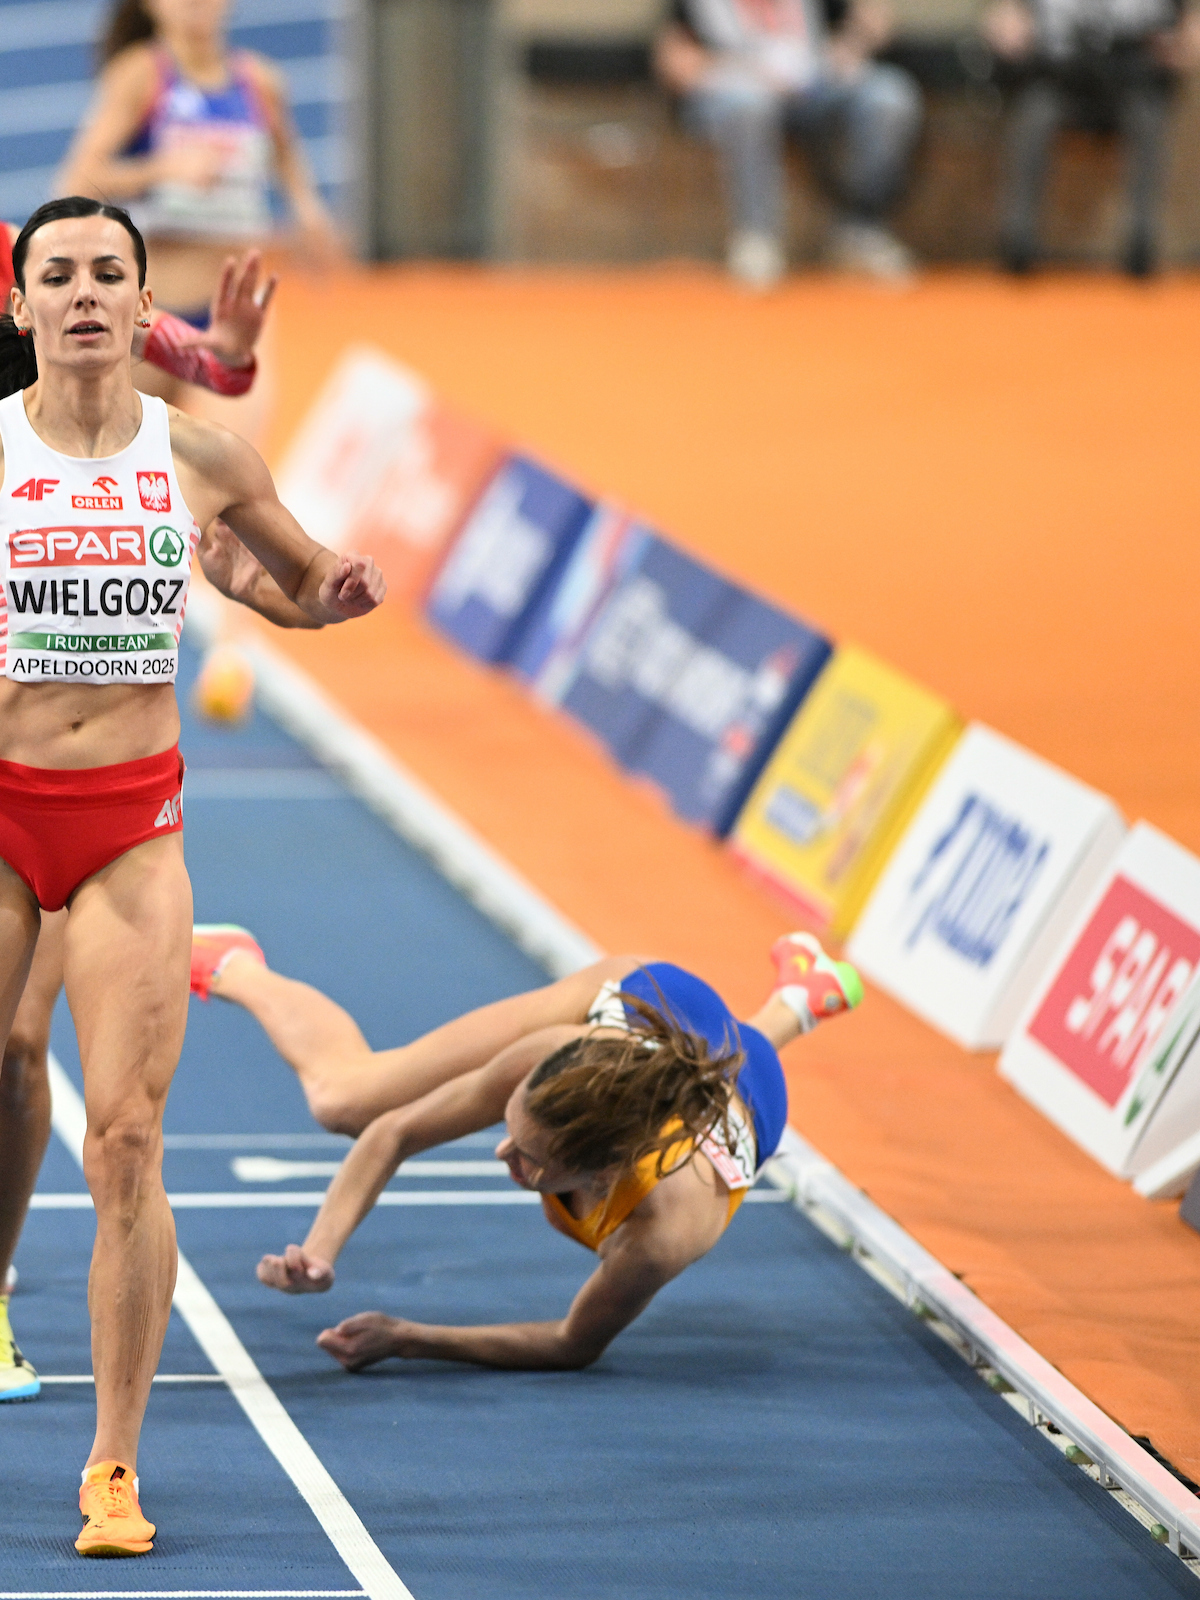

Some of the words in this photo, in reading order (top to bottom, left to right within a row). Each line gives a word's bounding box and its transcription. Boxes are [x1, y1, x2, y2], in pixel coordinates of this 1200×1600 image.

[74, 496, 120, 509] ORLEN
[11, 530, 143, 563] SPAR
[9, 577, 183, 617] WIELGOSZ
[46, 634, 51, 649] I
[55, 634, 92, 651] RUN
[12, 658, 137, 676] APELDOORN
[142, 658, 175, 675] 2025
